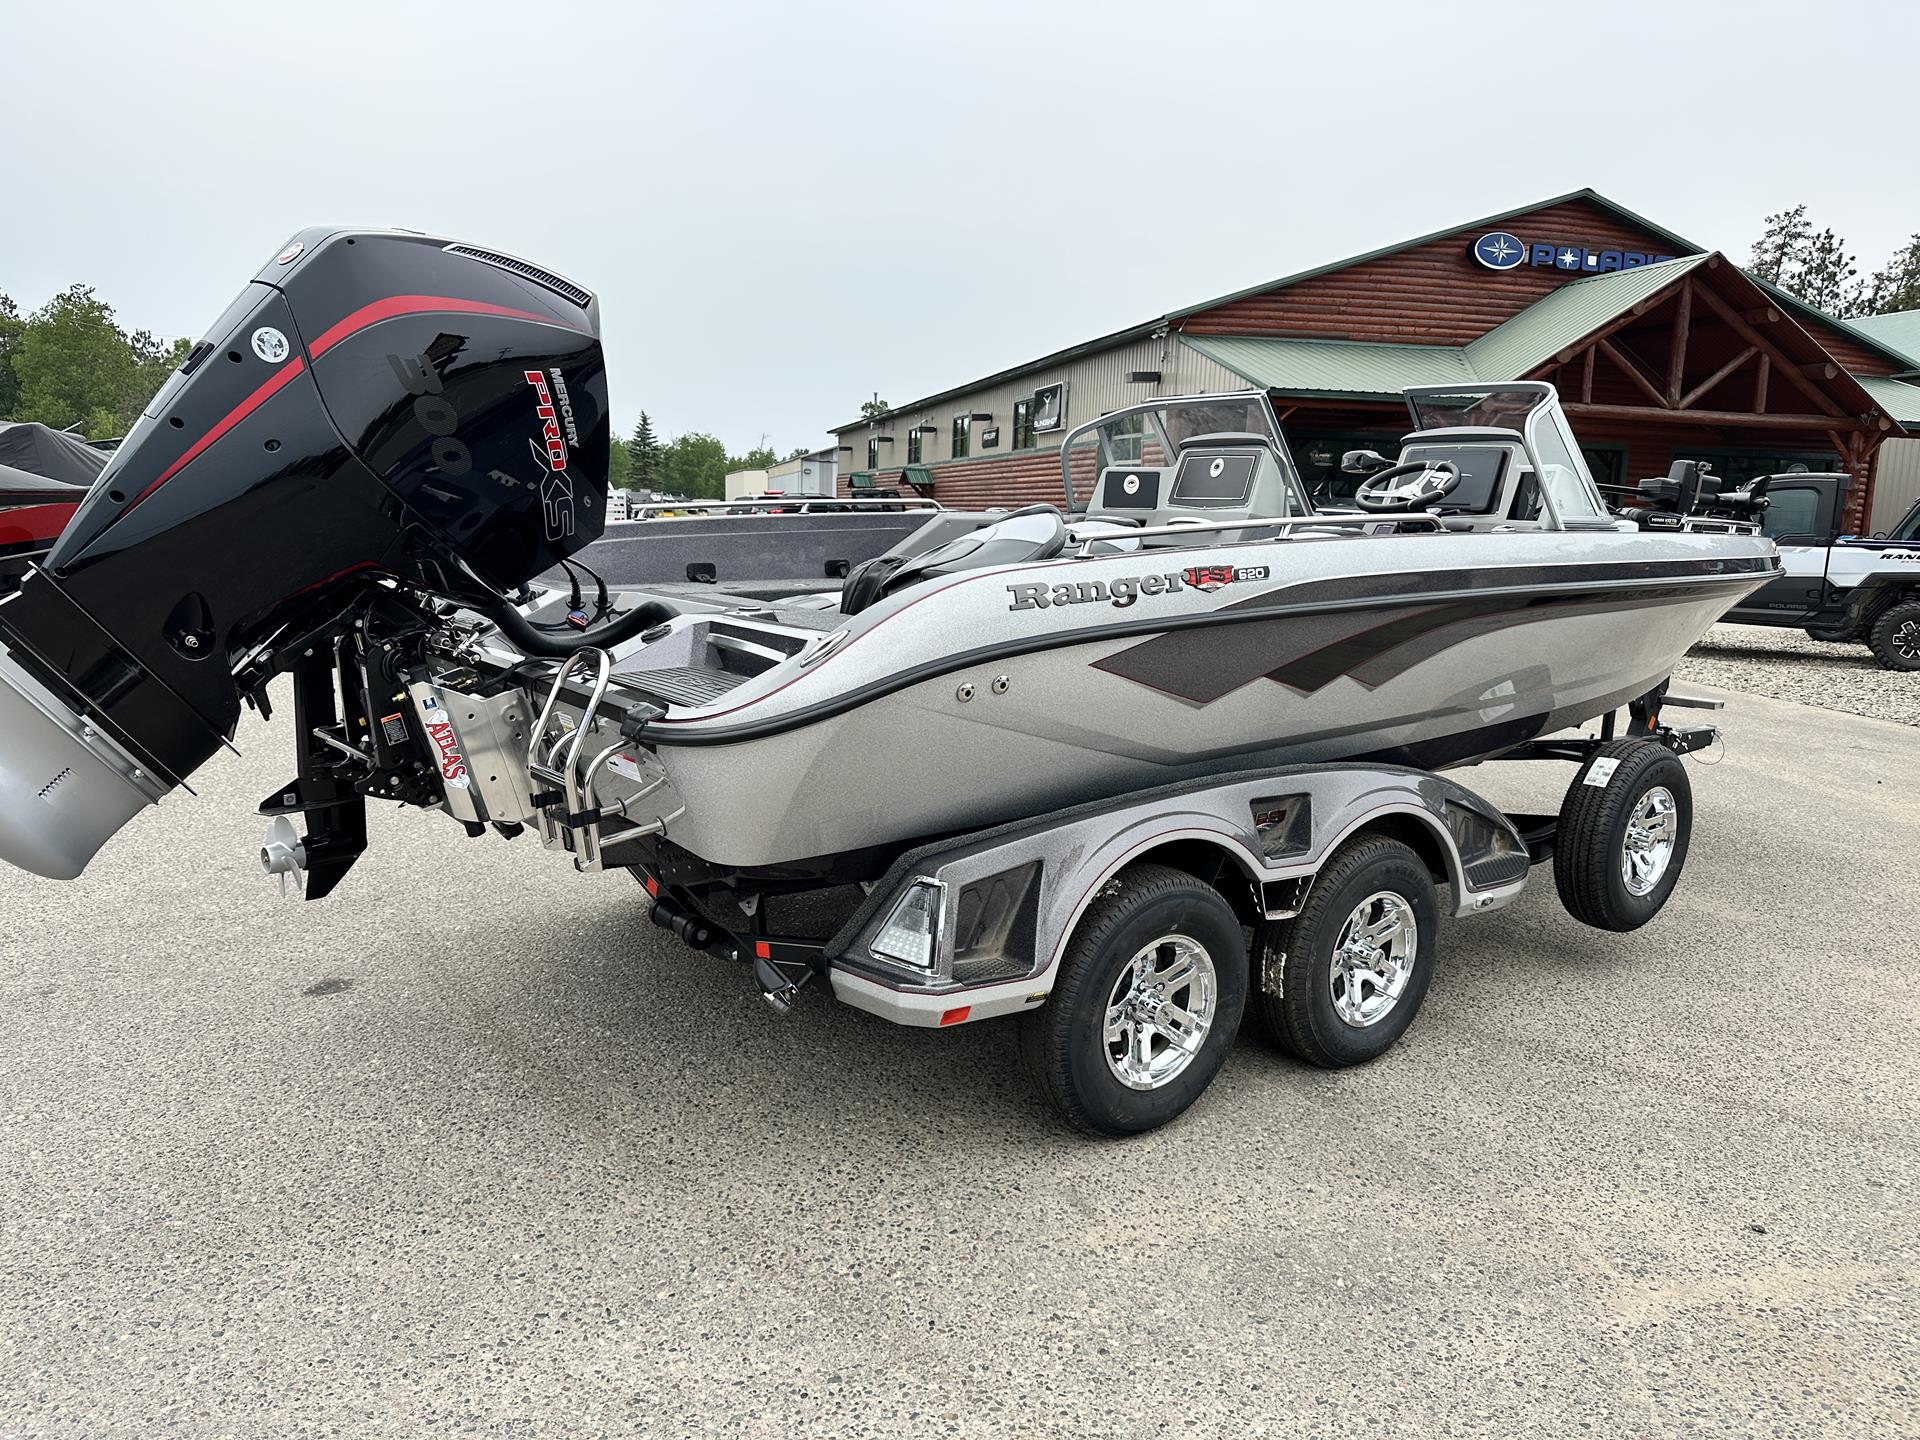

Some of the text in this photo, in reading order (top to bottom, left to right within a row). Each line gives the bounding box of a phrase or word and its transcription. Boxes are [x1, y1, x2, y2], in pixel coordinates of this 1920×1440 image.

[1529, 244, 1676, 273] POLARI
[385, 353, 473, 476] 300
[550, 367, 580, 448] MERCURY
[524, 370, 575, 541] PRO XS
[1006, 570, 1190, 611] Ranger
[1194, 565, 1227, 585] FS
[1238, 567, 1265, 580] 620
[1768, 602, 1808, 610] POLARIS
[424, 721, 469, 781] ATLAS
